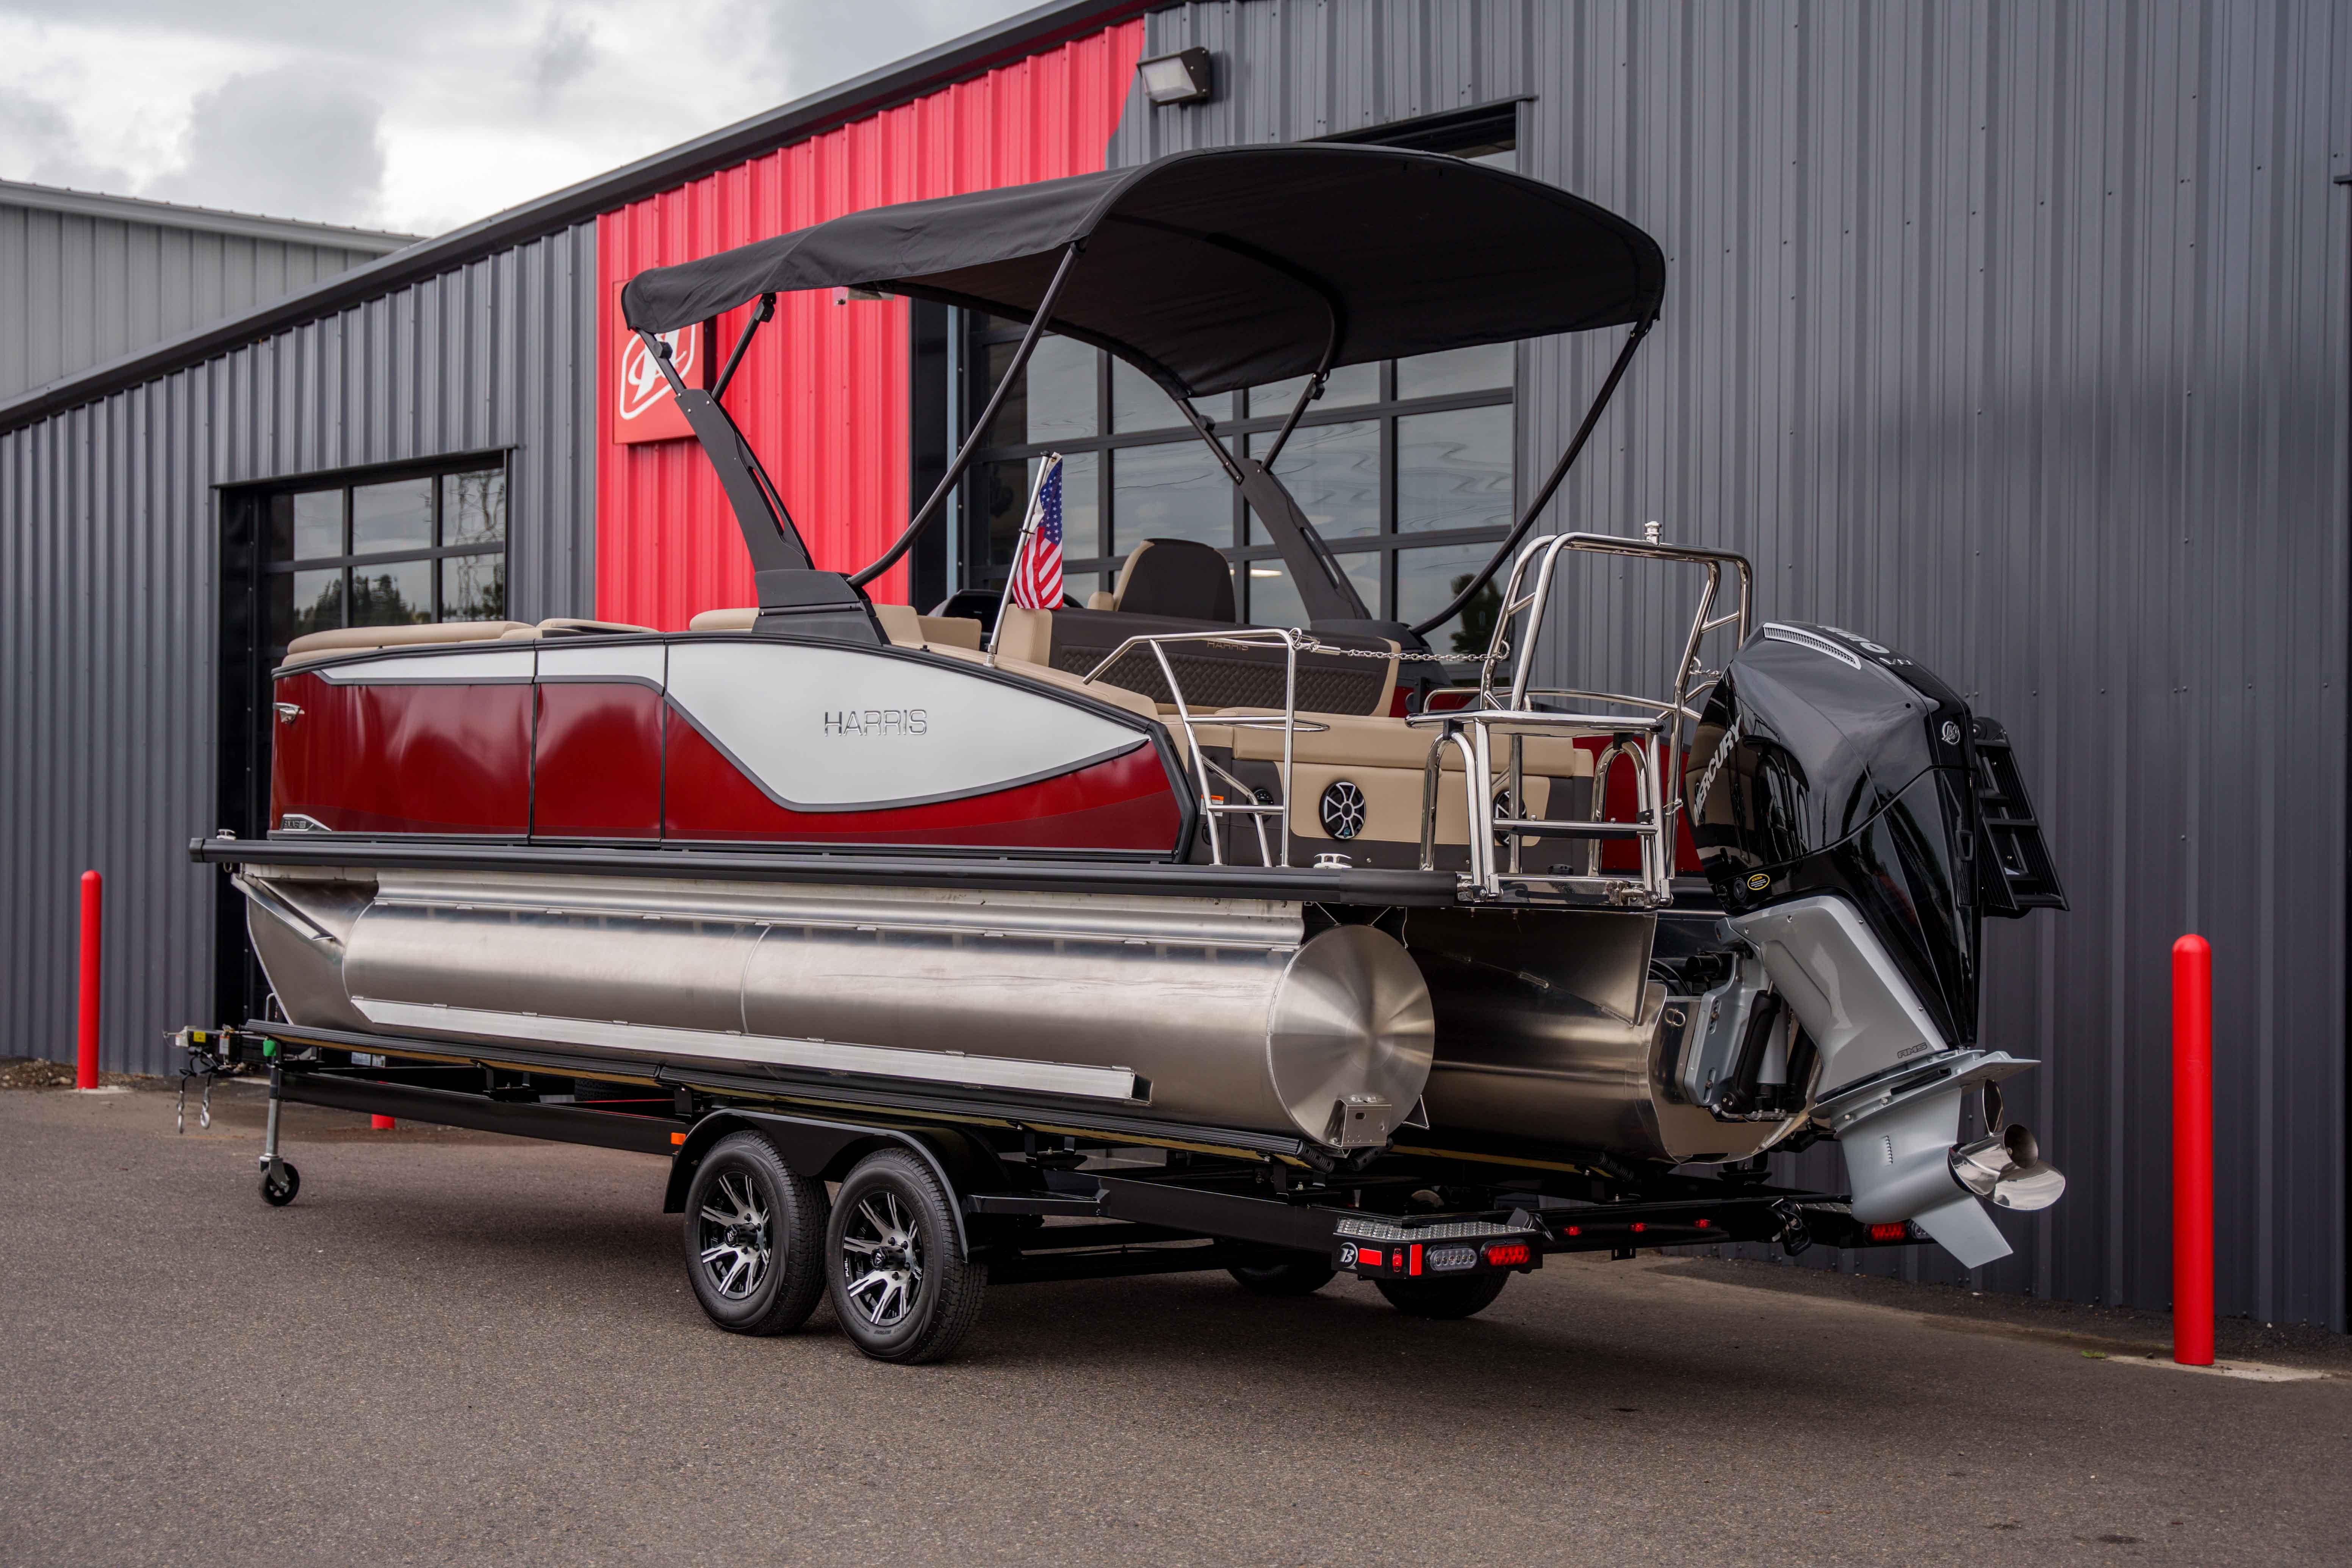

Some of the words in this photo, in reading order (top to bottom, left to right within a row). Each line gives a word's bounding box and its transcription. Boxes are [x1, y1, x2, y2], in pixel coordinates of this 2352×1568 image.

[824, 709, 927, 736] HARRIS
[1693, 714, 1741, 828] MERCURY
[1897, 1042, 1928, 1059] AMS
